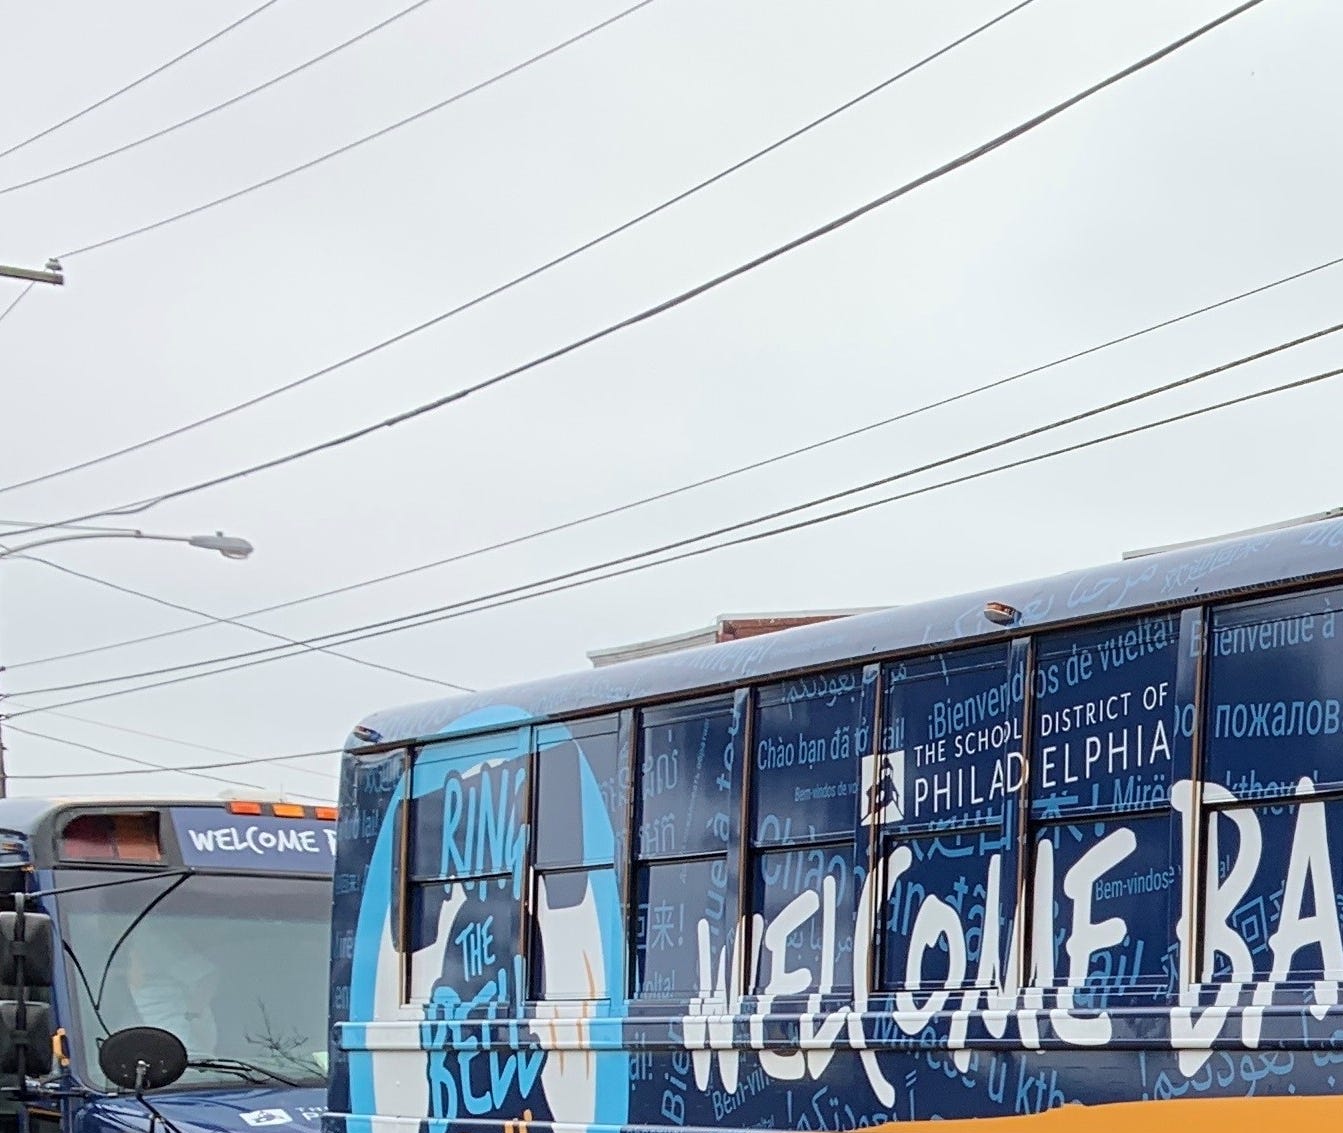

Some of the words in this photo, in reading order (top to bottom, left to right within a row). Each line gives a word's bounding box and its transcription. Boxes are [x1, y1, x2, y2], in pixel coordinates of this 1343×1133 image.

[1322, 599, 1336, 640] à
[1066, 646, 1093, 688] de
[757, 738, 795, 772] Chào
[797, 729, 825, 773] bạn
[830, 720, 849, 760] đã
[914, 741, 946, 770] THE
[954, 718, 1021, 759] SCHOOL
[1040, 692, 1131, 737] DISTRICT
[1143, 682, 1169, 709] OF
[914, 719, 1171, 818] PHILADELPHIA
[189, 827, 320, 854] WELCOME
[437, 763, 530, 903] RING
[454, 910, 495, 975] THE
[682, 827, 1147, 1108] WELCOME
